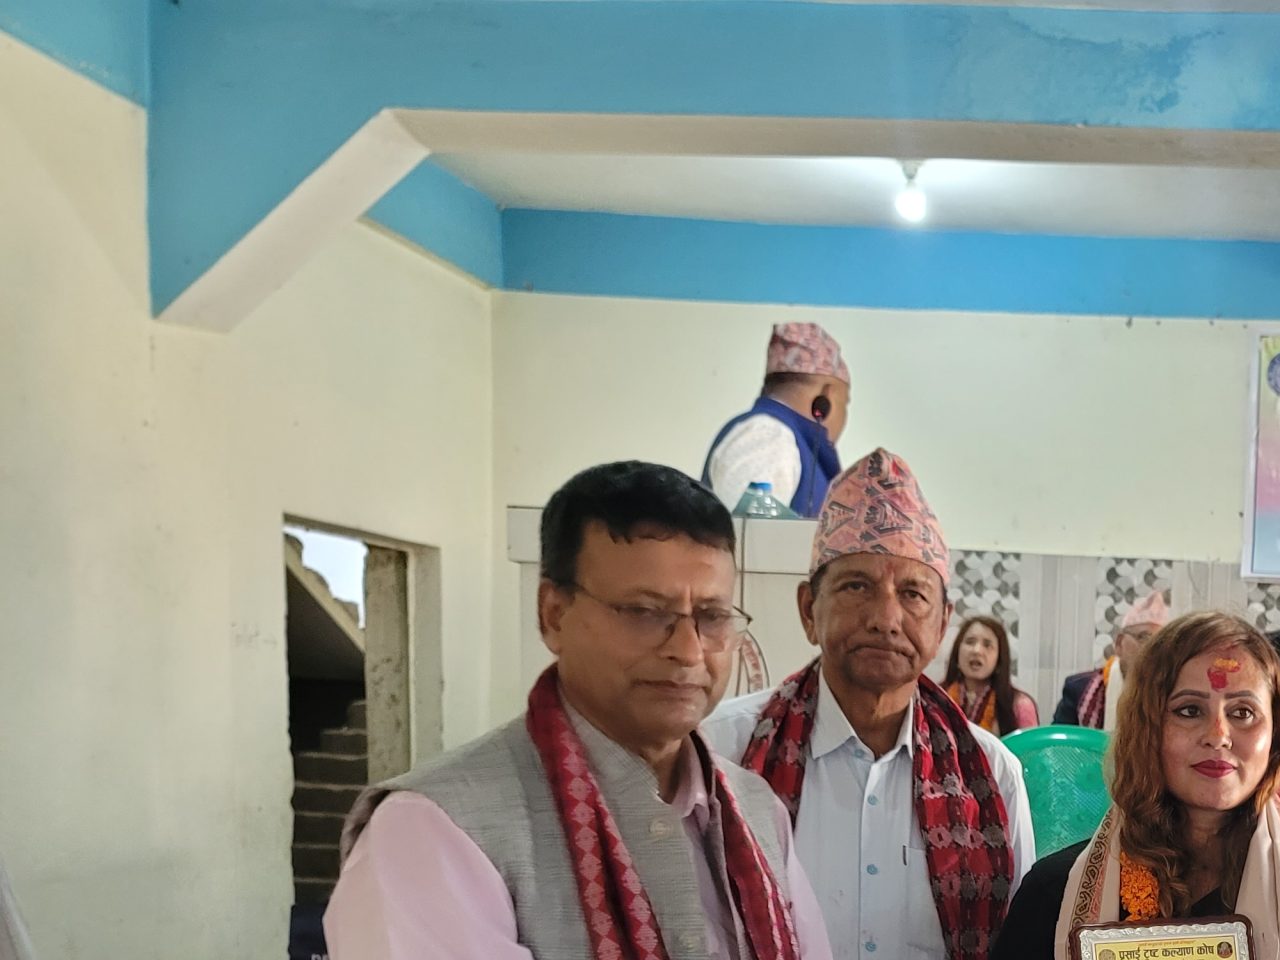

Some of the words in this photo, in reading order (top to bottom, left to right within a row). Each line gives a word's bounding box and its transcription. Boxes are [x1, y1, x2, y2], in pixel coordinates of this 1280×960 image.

[1119, 947, 1141, 960] प्रसाई
[1144, 949, 1159, 960] ट्रष्ट
[1162, 946, 1194, 957] कल्याण
[1197, 943, 1214, 955] कोष
